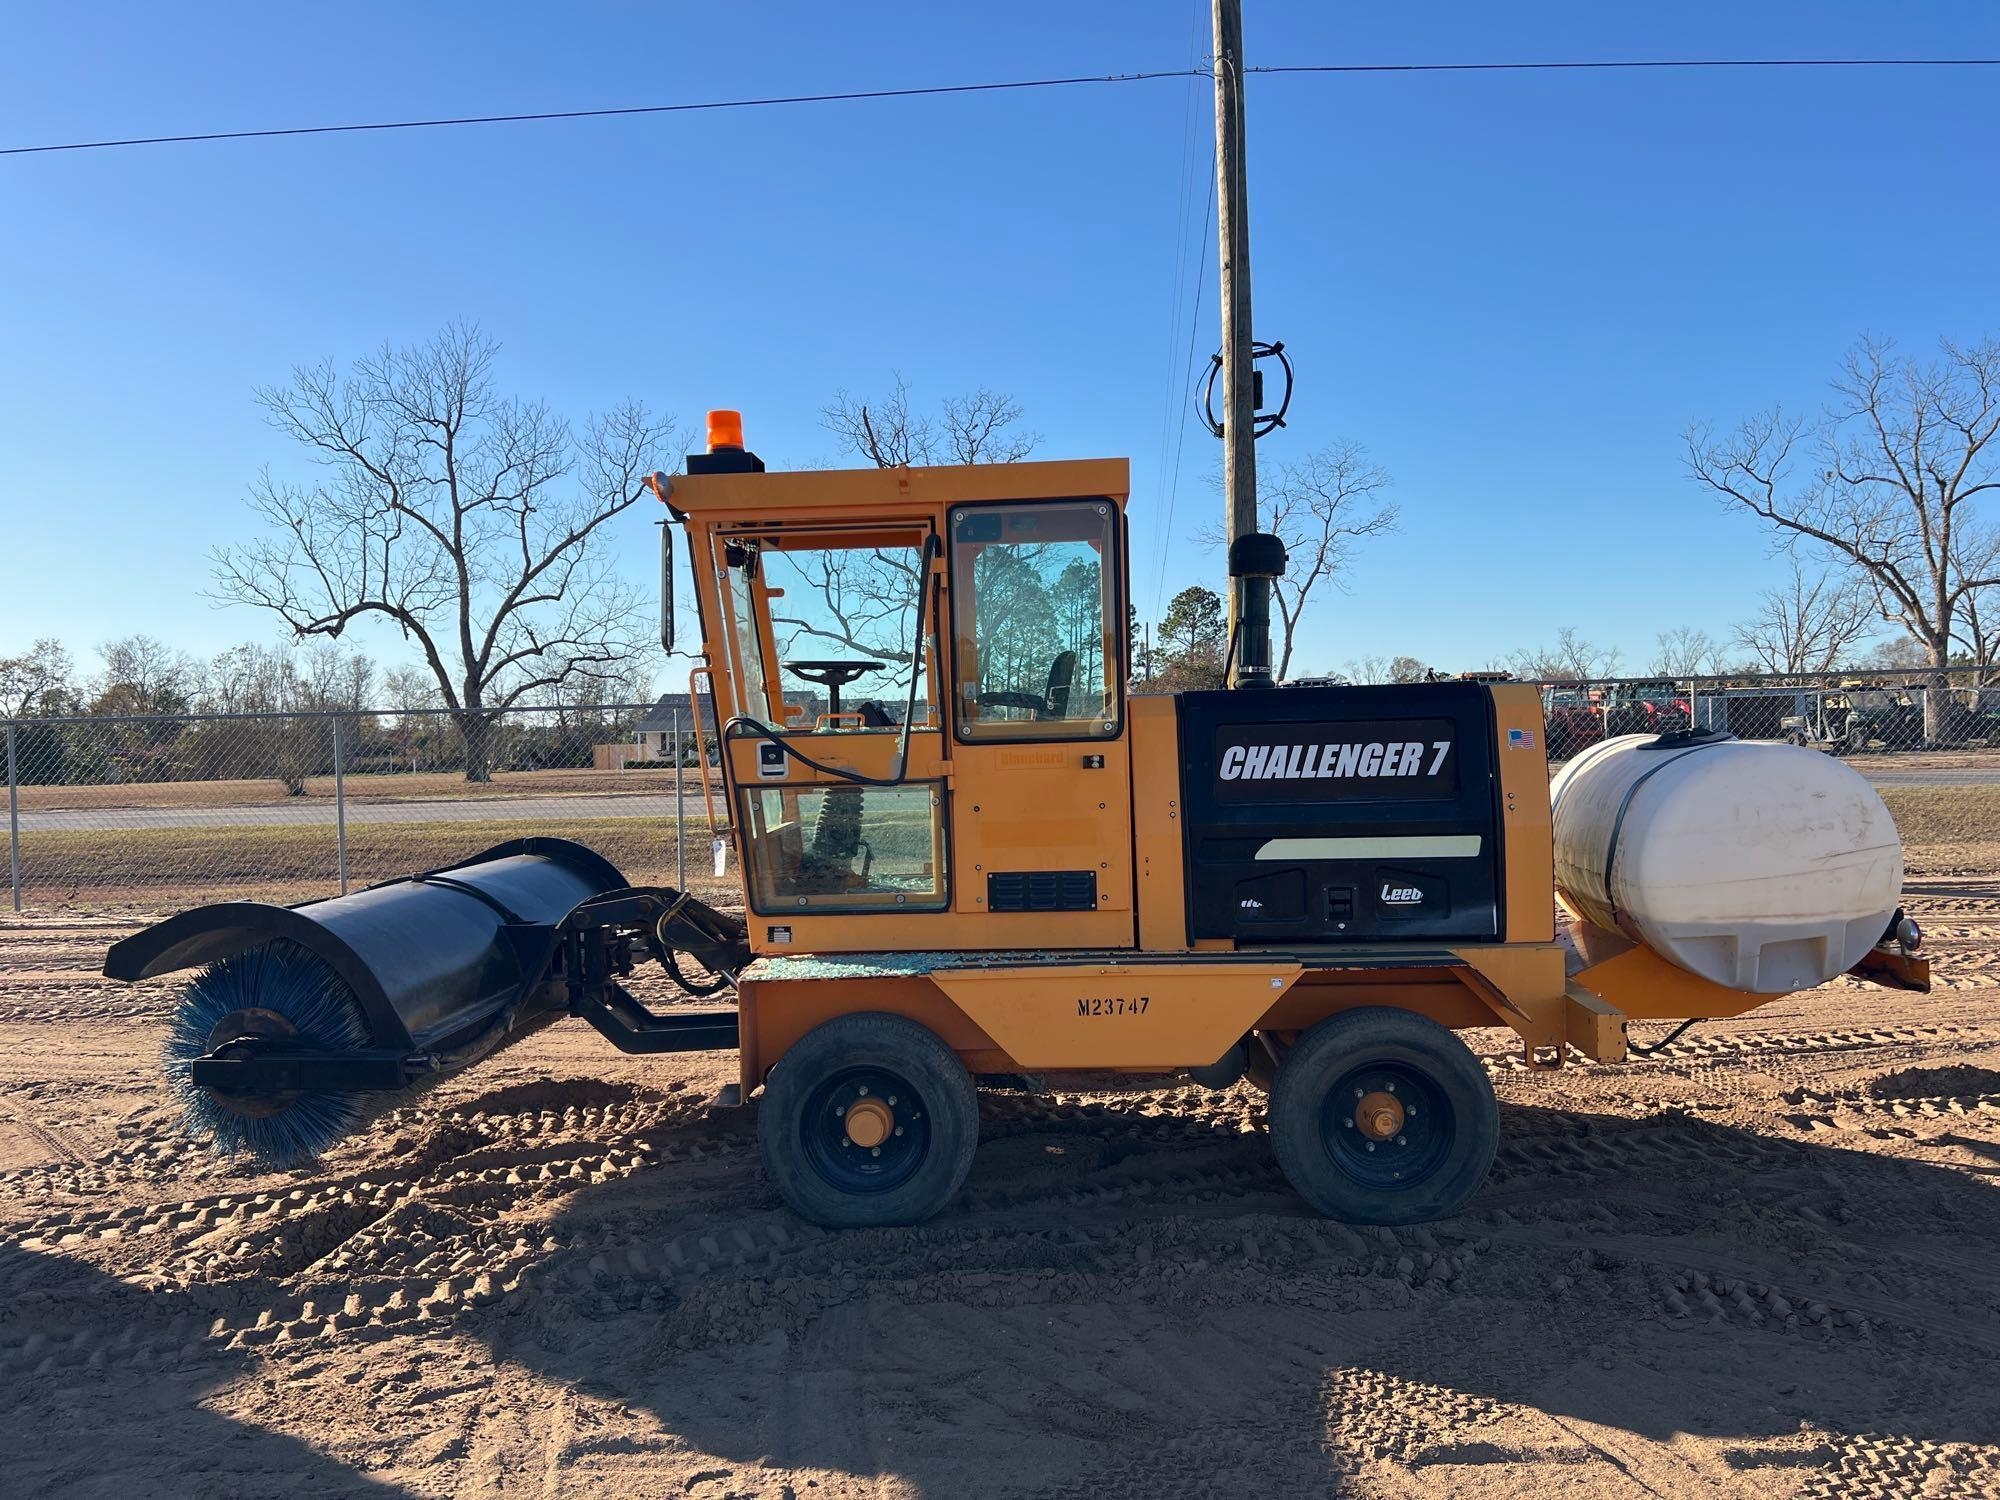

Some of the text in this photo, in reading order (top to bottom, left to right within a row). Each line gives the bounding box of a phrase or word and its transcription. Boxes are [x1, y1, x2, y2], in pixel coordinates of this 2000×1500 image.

[1219, 741, 1451, 781] CHALLENGER 7
[1078, 997, 1149, 1016] M23747
